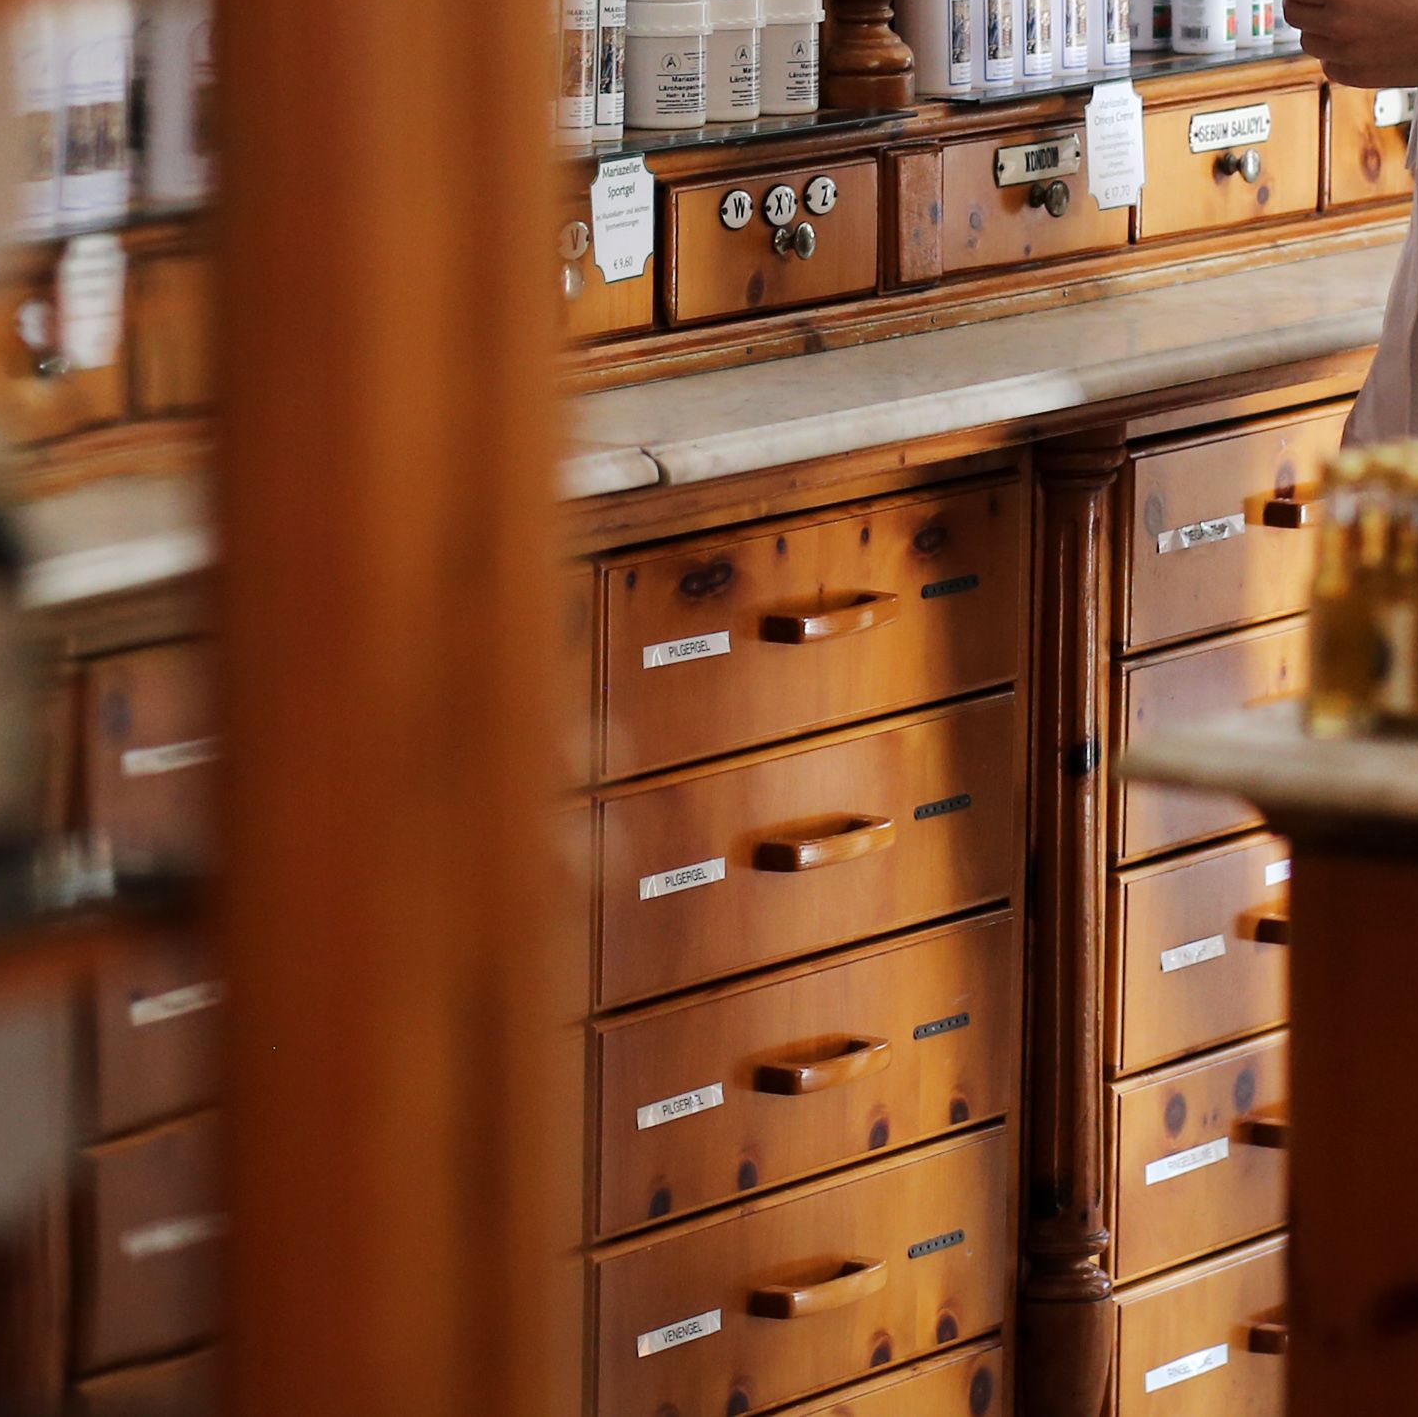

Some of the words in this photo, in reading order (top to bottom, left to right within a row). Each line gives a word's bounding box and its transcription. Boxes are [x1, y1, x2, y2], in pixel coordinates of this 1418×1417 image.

[1198, 122, 1229, 143] SEBUM
[1230, 115, 1266, 138] SALICYL
[1025, 146, 1059, 172] KONDOM
[602, 162, 641, 179] Mariazeller
[607, 182, 636, 200] Sportgel
[821, 184, 830, 207] Z
[733, 197, 745, 219] W
[569, 228, 580, 251] V
[668, 638, 711, 659] PILGERGEL
[664, 868, 708, 889] PILGERGEL
[662, 1321, 704, 1345] VENENGEL
